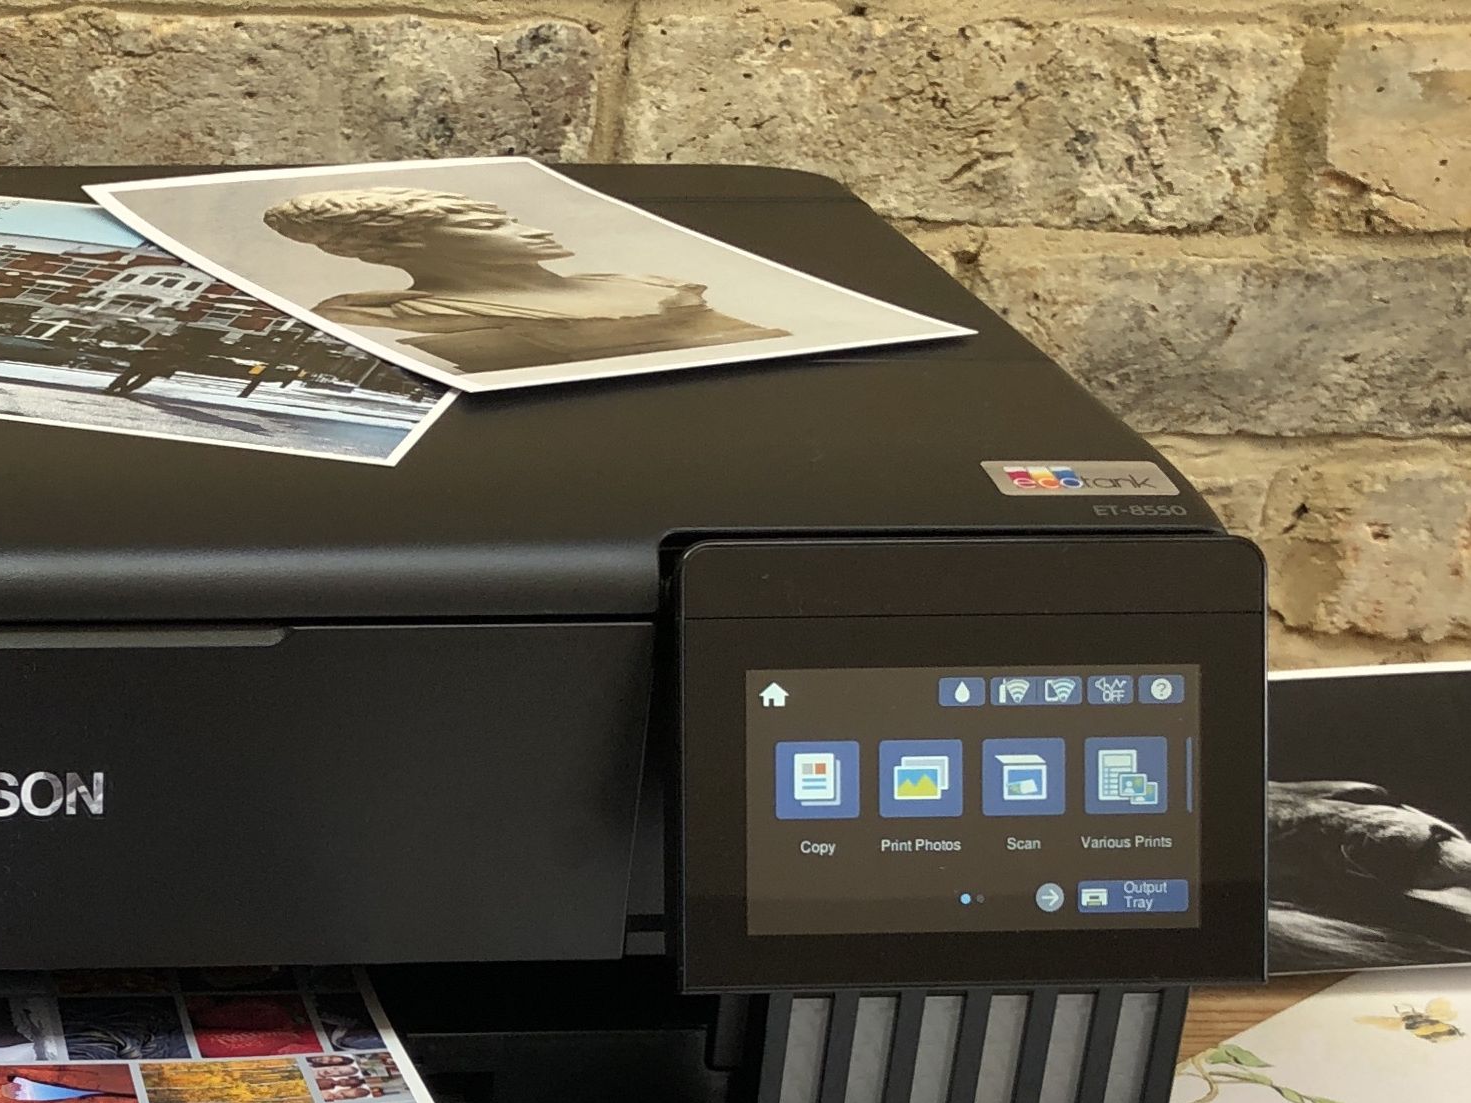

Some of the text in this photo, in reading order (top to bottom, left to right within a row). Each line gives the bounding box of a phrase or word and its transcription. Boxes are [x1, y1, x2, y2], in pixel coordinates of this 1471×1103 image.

[1093, 504, 1187, 517] ET-8550
[1102, 690, 1125, 702] OFF
[800, 840, 836, 856] Copy
[881, 838, 961, 852] Print Photos
[1006, 836, 1041, 851] Scan
[1080, 834, 1173, 849] Various Prints
[1123, 881, 1167, 896] Output
[1123, 896, 1155, 911] Tray
